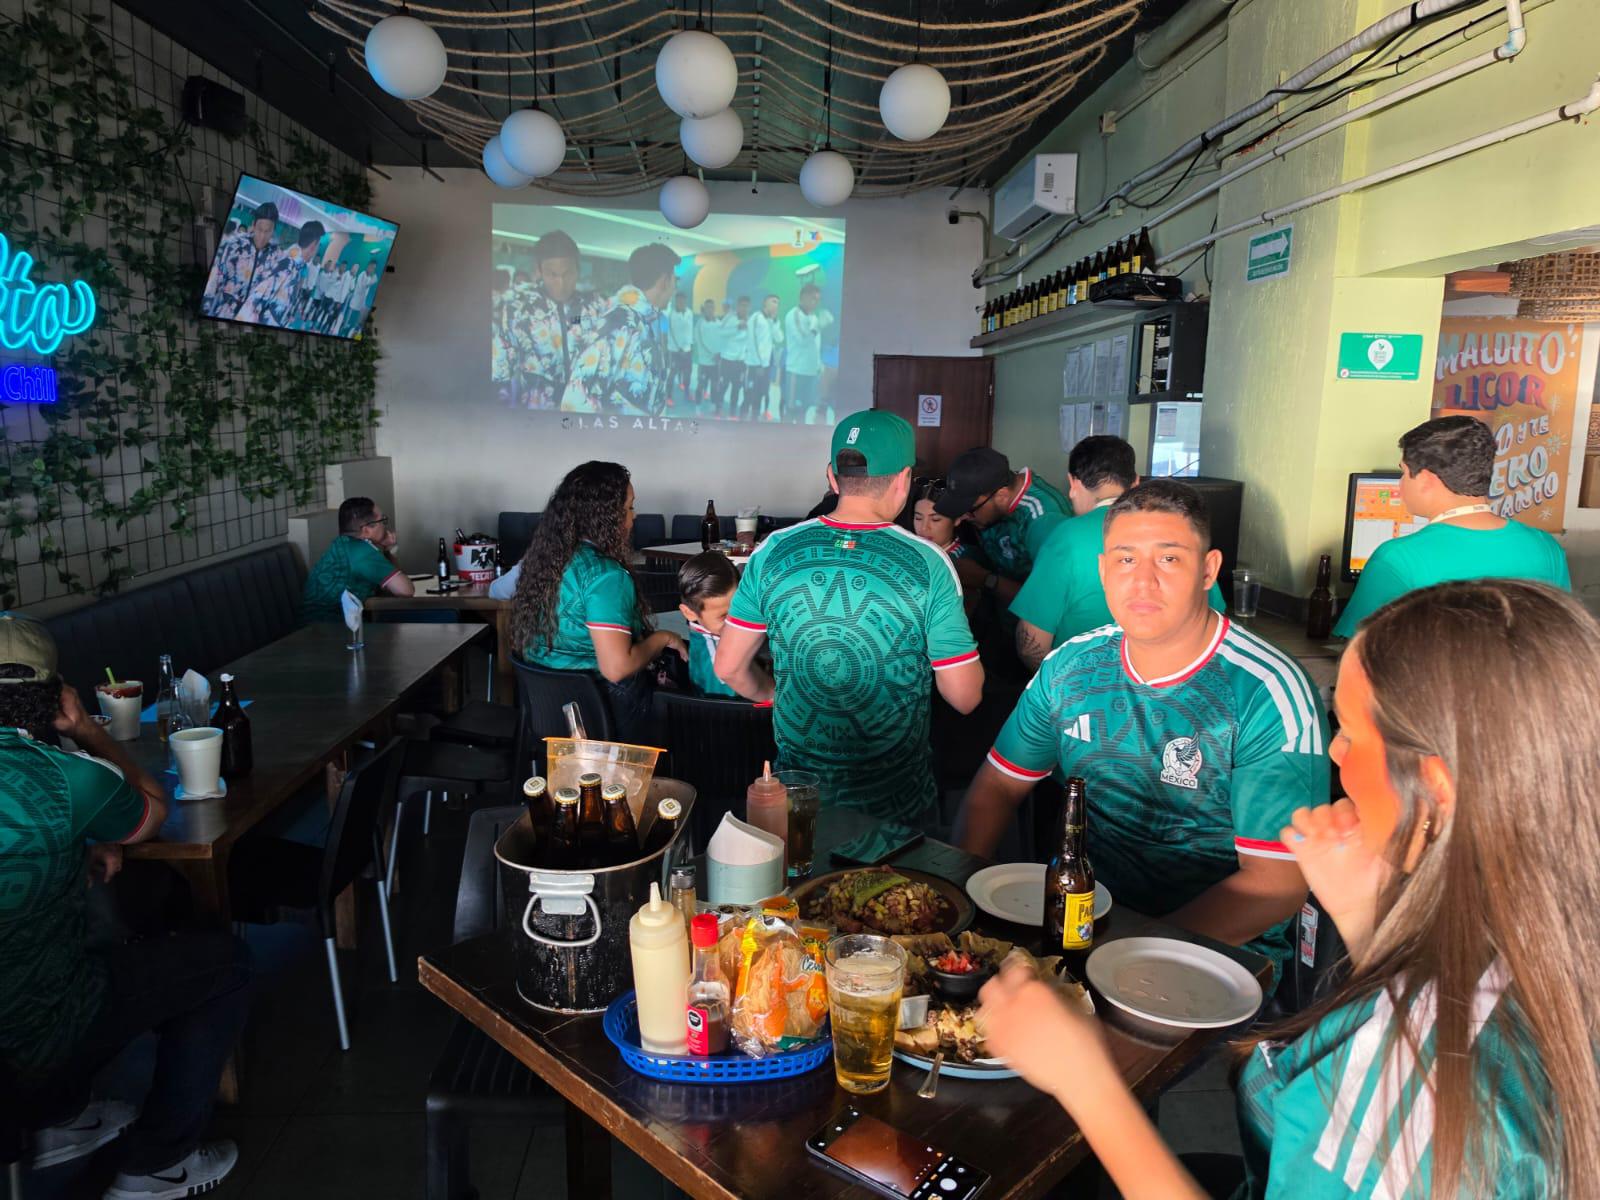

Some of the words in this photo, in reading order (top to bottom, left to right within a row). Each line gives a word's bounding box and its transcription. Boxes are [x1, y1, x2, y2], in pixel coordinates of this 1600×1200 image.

[1436, 331, 1566, 382] MALDITO
[3, 366, 56, 401] Chill
[1445, 371, 1548, 411] LICOR
[1161, 773, 1196, 787] MEXICO
